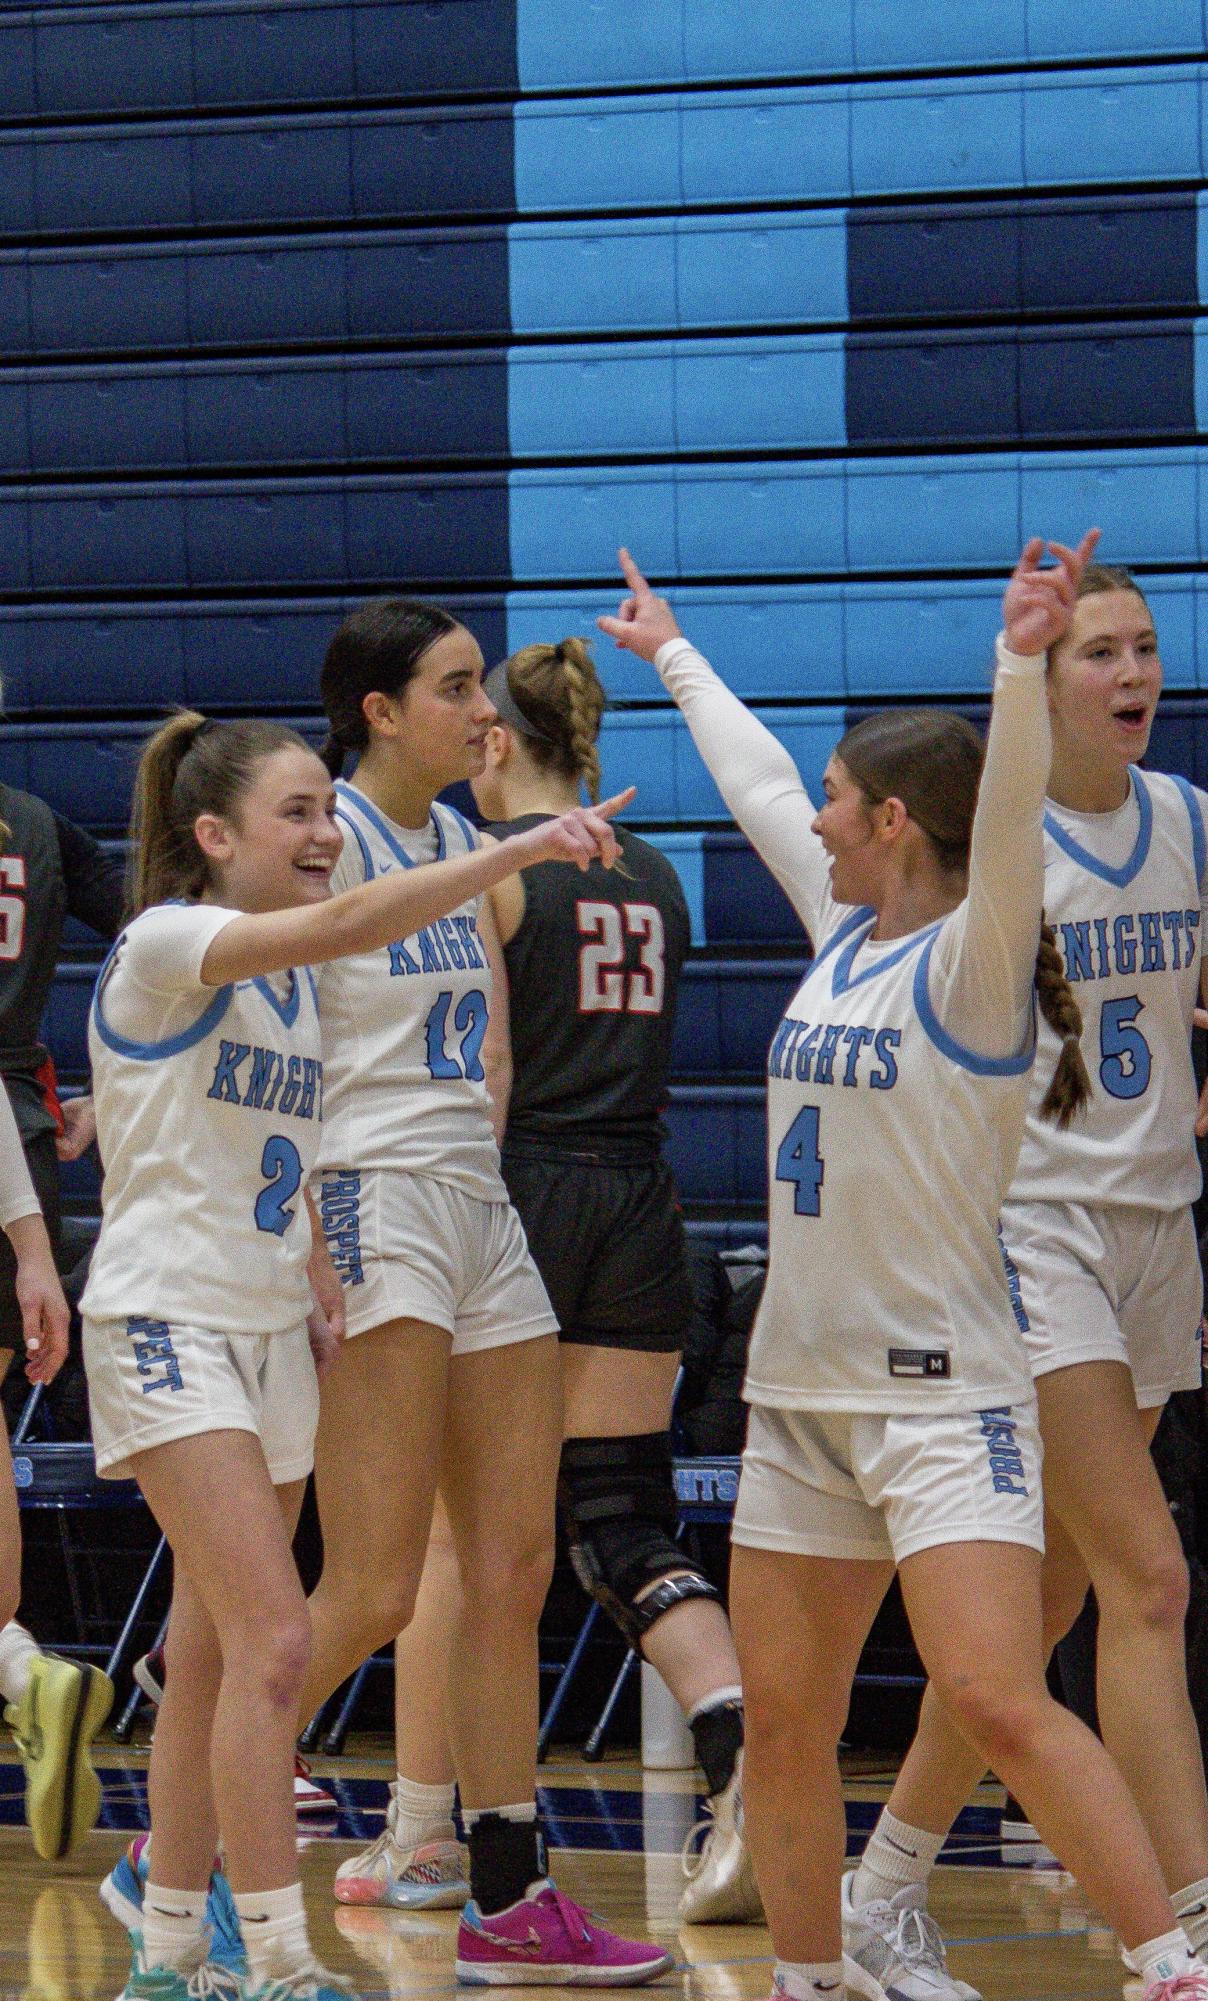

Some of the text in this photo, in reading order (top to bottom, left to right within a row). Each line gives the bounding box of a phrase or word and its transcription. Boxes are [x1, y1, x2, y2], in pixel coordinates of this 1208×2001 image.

[576, 899, 665, 1014] 23
[1050, 909, 1200, 982] NIGHTS
[424, 989, 489, 1081] 12
[1100, 995, 1153, 1100] 5
[254, 1135, 304, 1237] 2
[775, 1105, 824, 1217] 4
[931, 1359, 943, 1371] M
